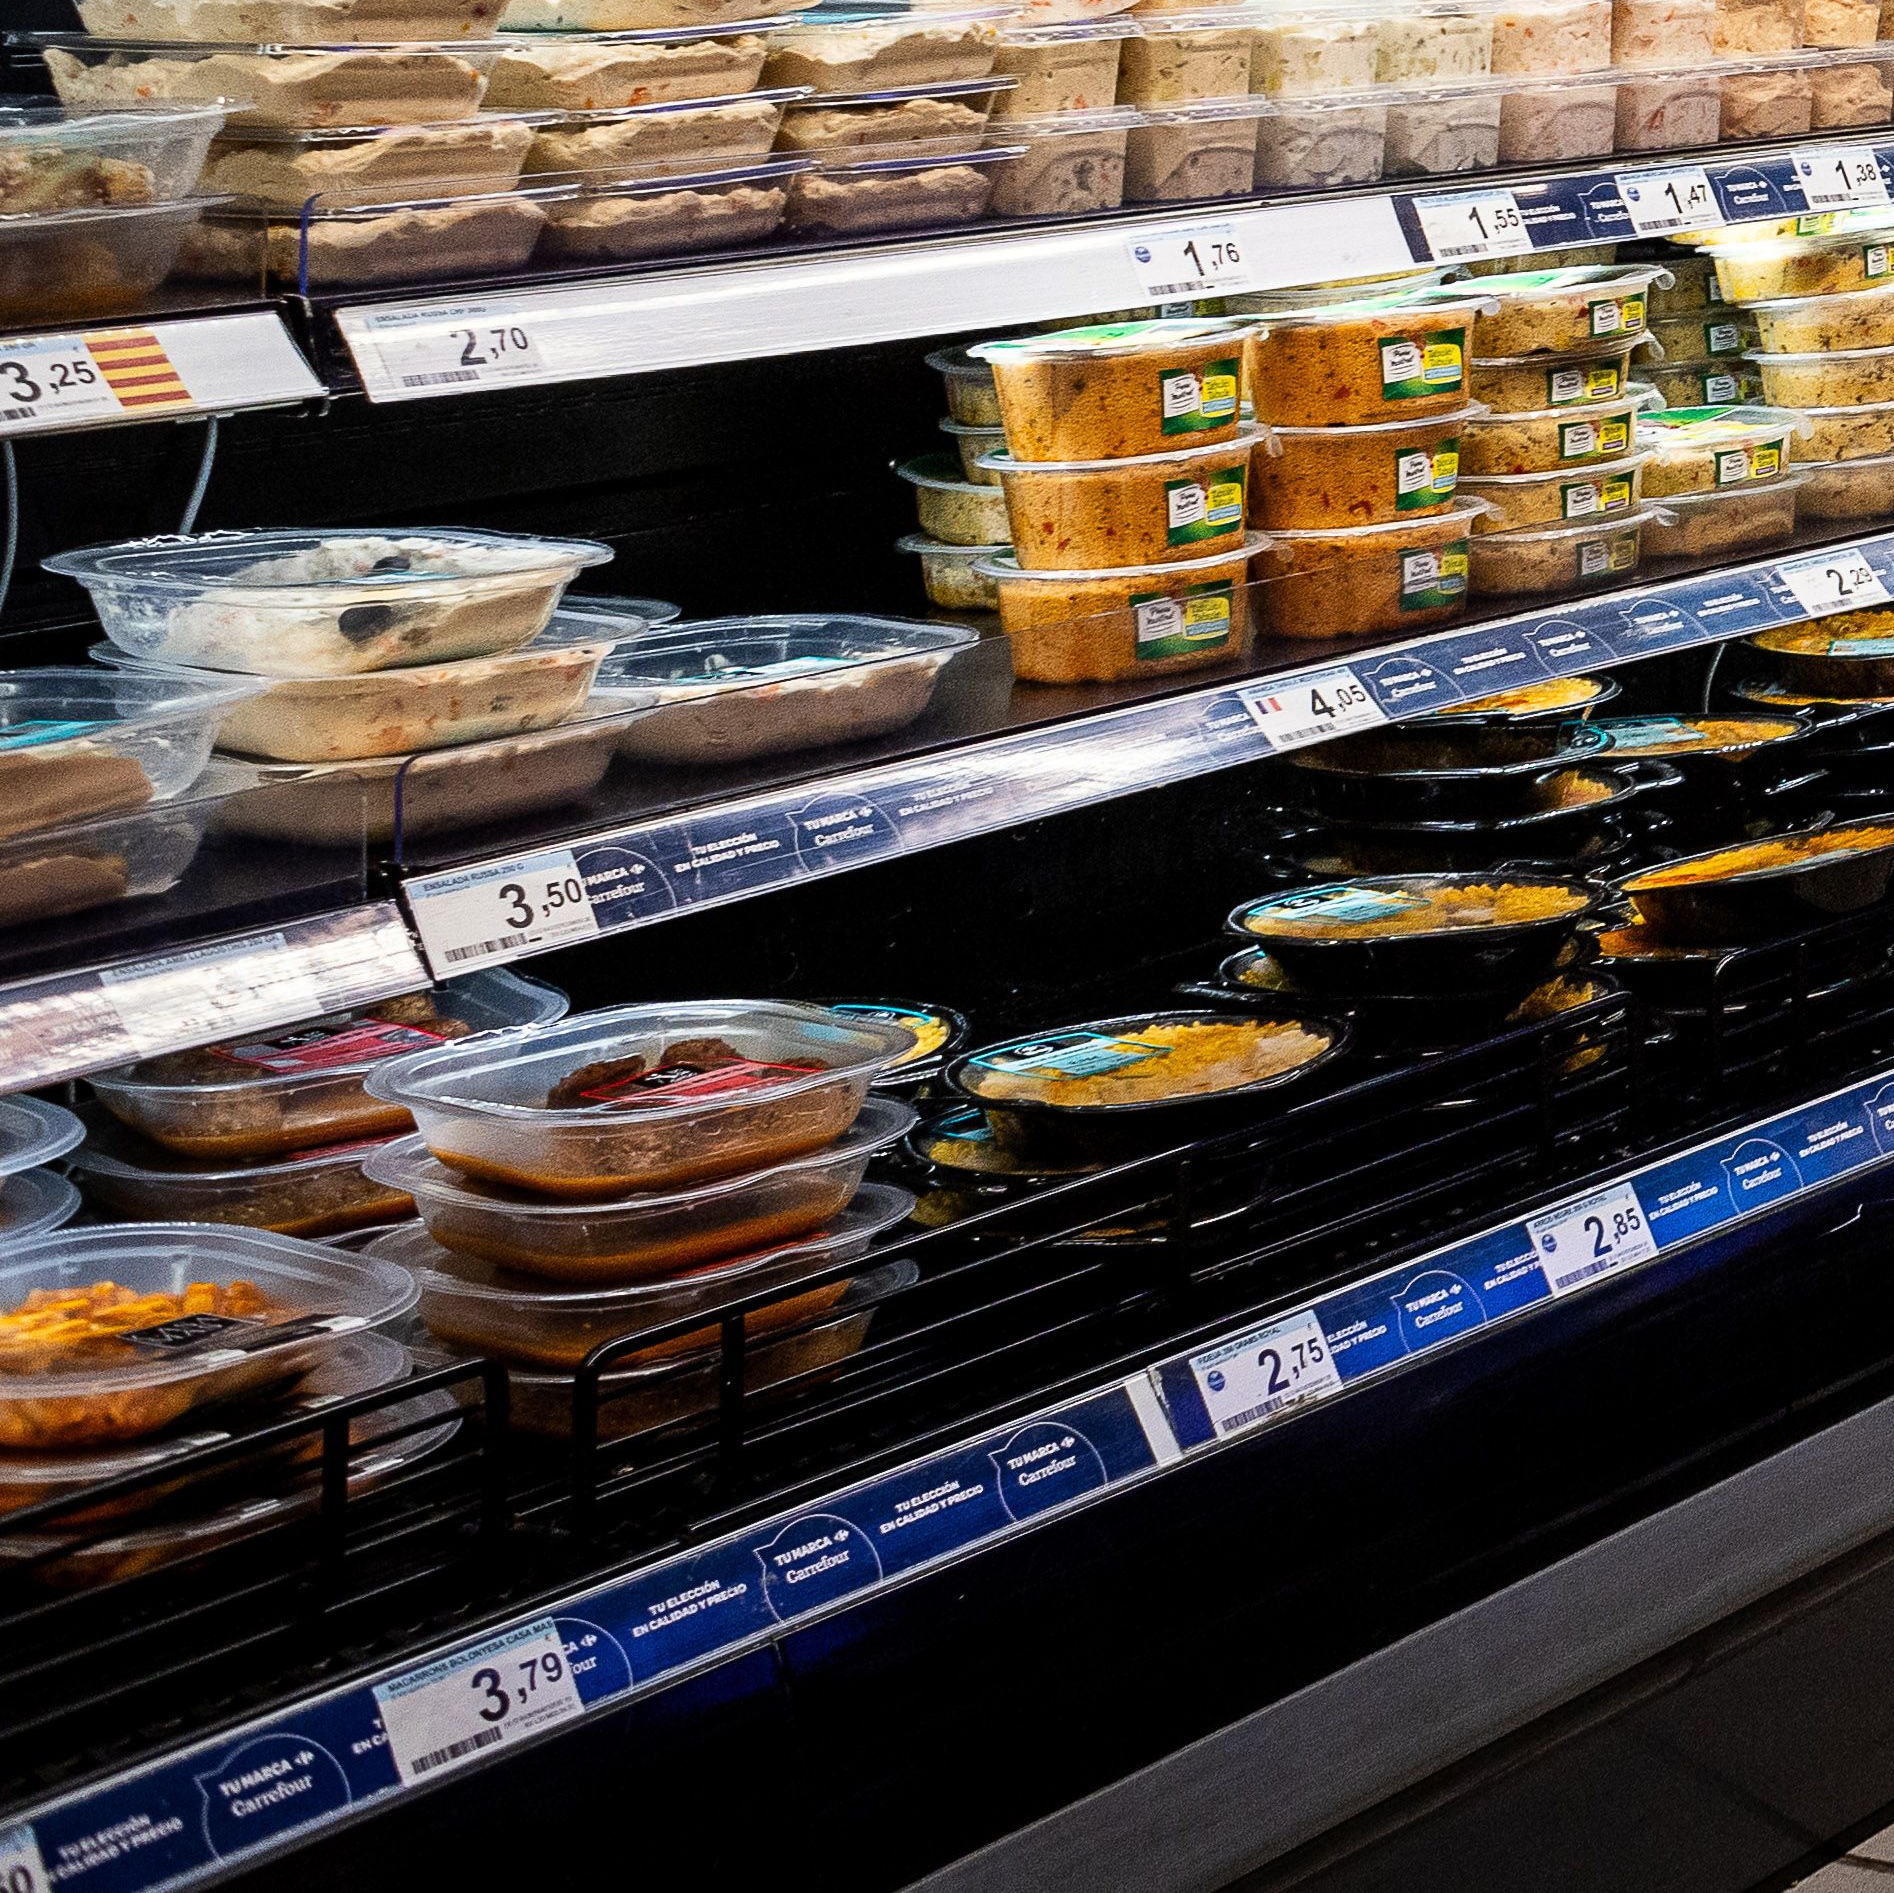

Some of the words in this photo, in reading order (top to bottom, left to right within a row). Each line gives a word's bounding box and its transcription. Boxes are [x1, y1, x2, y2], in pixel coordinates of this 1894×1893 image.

[1834, 160, 1877, 192] 1,38
[1663, 181, 1707, 215] 1,47
[1467, 207, 1521, 240] 1,55
[1182, 240, 1241, 277] 1,76
[449, 327, 529, 367] 2,70
[1825, 566, 1873, 598] 2,29
[1310, 683, 1368, 719] 4,05
[804, 818, 818, 833] TU
[819, 809, 858, 830] MARCA
[814, 822, 875, 849] Carrefour
[692, 842, 707, 856] TU
[422, 873, 469, 892] ENSALADA
[470, 867, 499, 882] RUSSA
[588, 878, 645, 908] arrefour
[498, 876, 584, 931] 3,50
[1583, 1206, 1641, 1259] 2,85
[1257, 1336, 1325, 1396] 2,75
[1006, 1455, 1023, 1470] TU
[1022, 1440, 1059, 1466] MARCA
[1016, 1454, 1077, 1488] Carrefour
[880, 1521, 895, 1534] EN
[895, 1504, 939, 1529] CALIDAD
[947, 1483, 984, 1506] PRECIO
[895, 1499, 911, 1513] TU
[774, 1551, 791, 1568] TU
[791, 1535, 833, 1563] MARCA
[784, 1547, 852, 1585] Carrefour
[632, 1622, 649, 1639] EN
[650, 1601, 699, 1631] CALIDAD
[708, 1581, 748, 1606] PRECIO
[648, 1601, 667, 1616] TU
[668, 1578, 721, 1611] ELECCIÓN
[504, 1629, 532, 1652] CASA
[471, 1651, 565, 1722] 3,79
[218, 1780, 241, 1797] TU
[241, 1759, 293, 1790] MARCA
[229, 1773, 314, 1818] Carrefour
